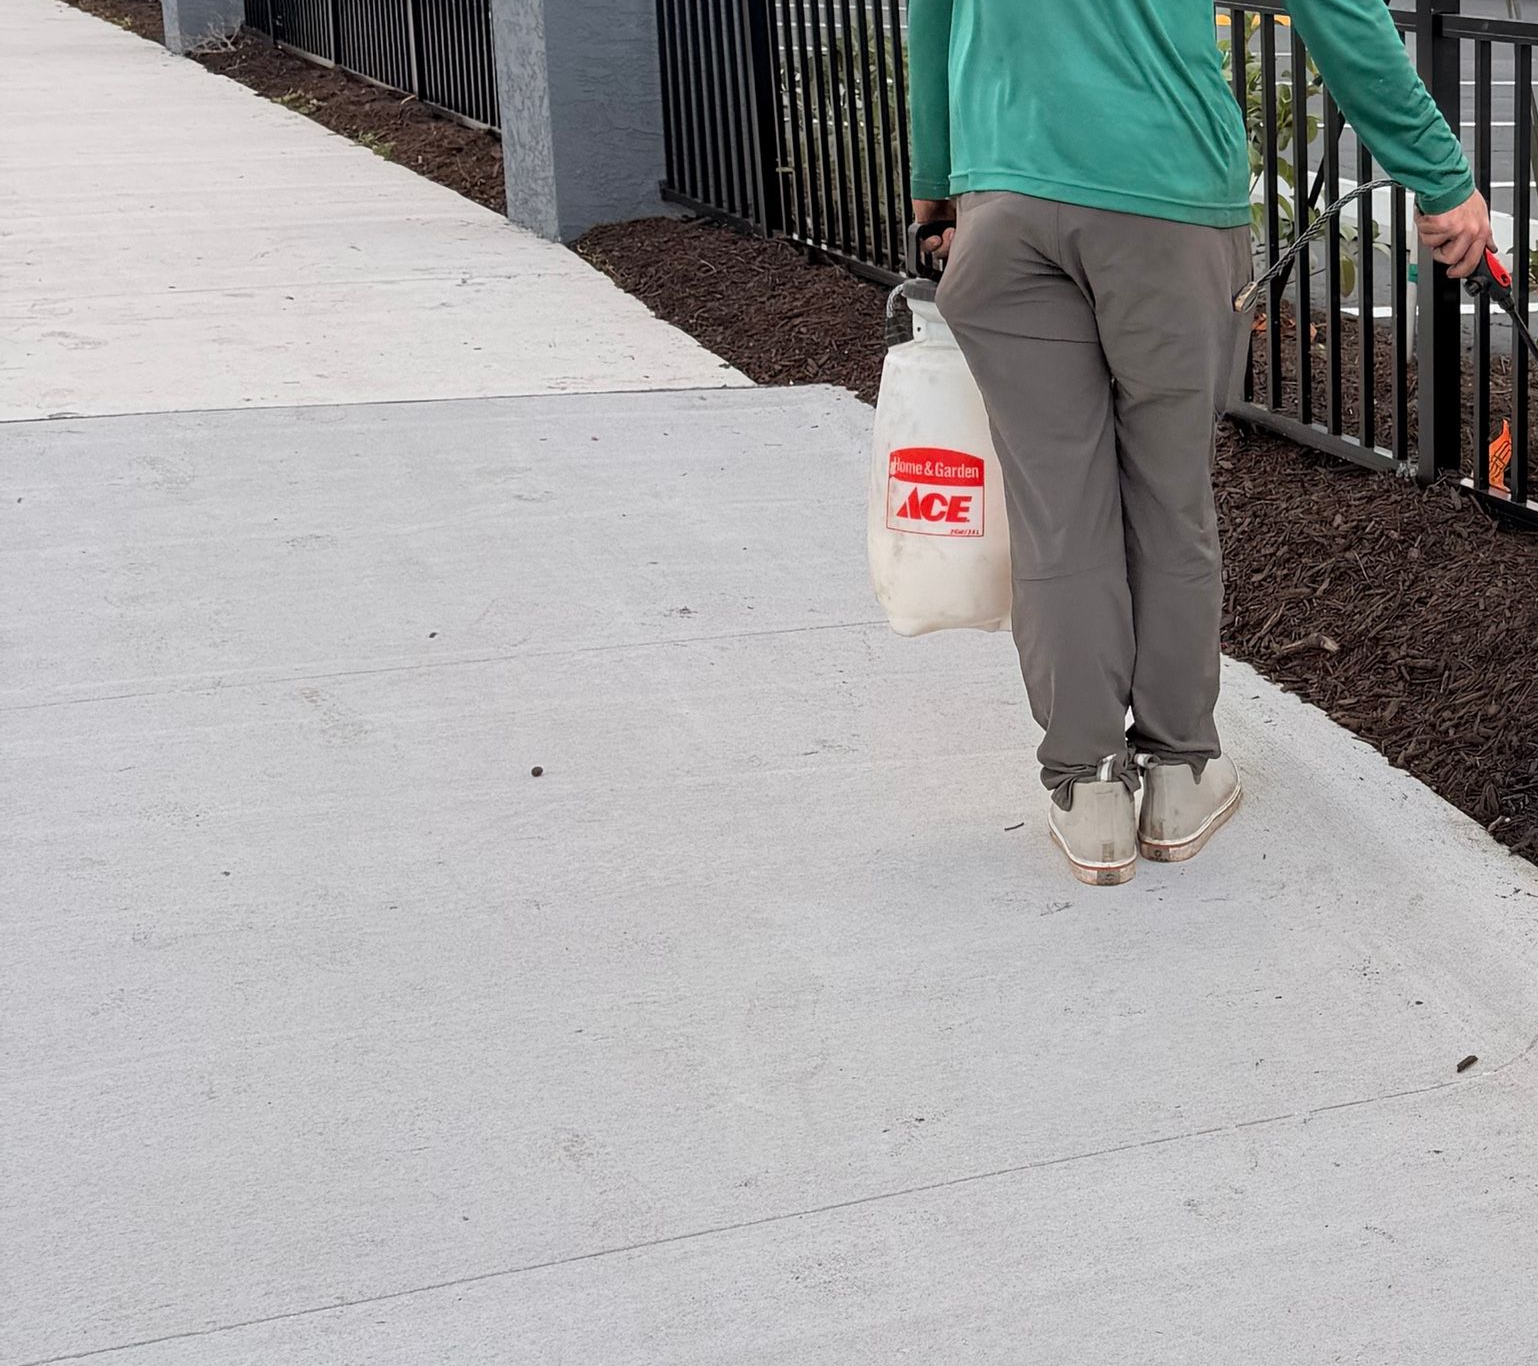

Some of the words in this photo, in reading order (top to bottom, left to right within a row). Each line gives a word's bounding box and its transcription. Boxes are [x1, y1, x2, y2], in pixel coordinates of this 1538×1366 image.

[890, 456, 922, 475] Home
[924, 461, 934, 475] &
[935, 463, 979, 478] Garden
[896, 487, 972, 523] ACE
